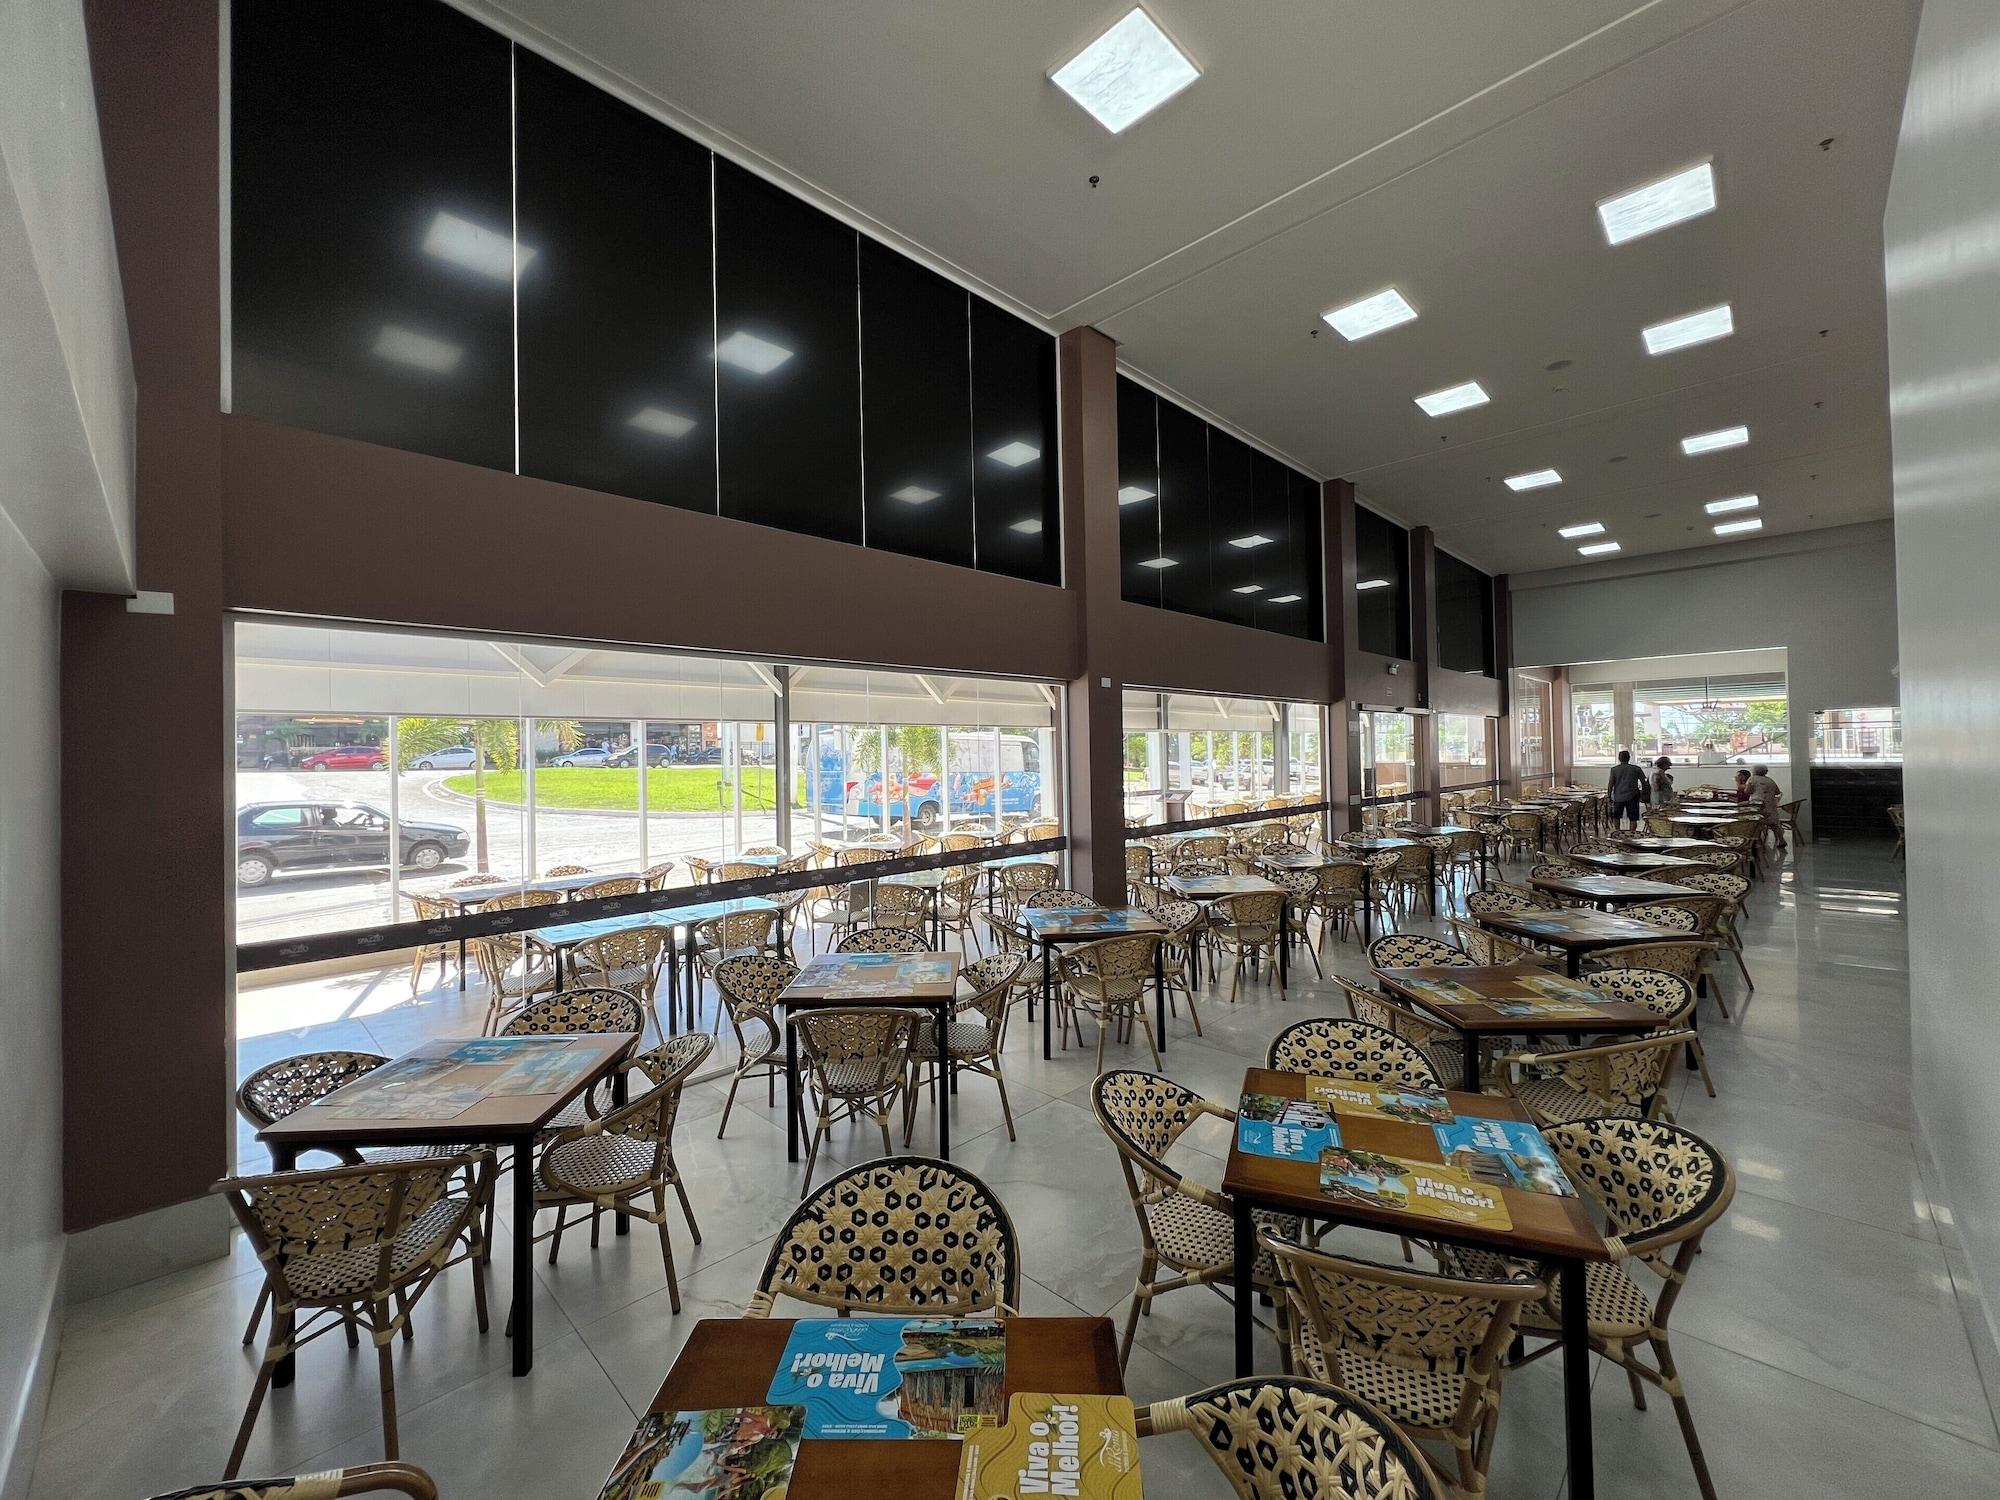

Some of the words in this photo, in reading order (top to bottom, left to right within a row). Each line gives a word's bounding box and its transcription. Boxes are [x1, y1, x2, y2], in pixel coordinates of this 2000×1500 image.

[1414, 1177, 1457, 1193] Viva
[1460, 1186, 1474, 1196] o
[1416, 1186, 1495, 1209] Melhor!
[790, 1353, 884, 1373] Melhor!
[806, 1373, 823, 1388] o
[828, 1373, 879, 1394] Viva
[1029, 1421, 1050, 1436] o
[1051, 1404, 1081, 1496] Melhor!
[1018, 1441, 1050, 1494] Viva
